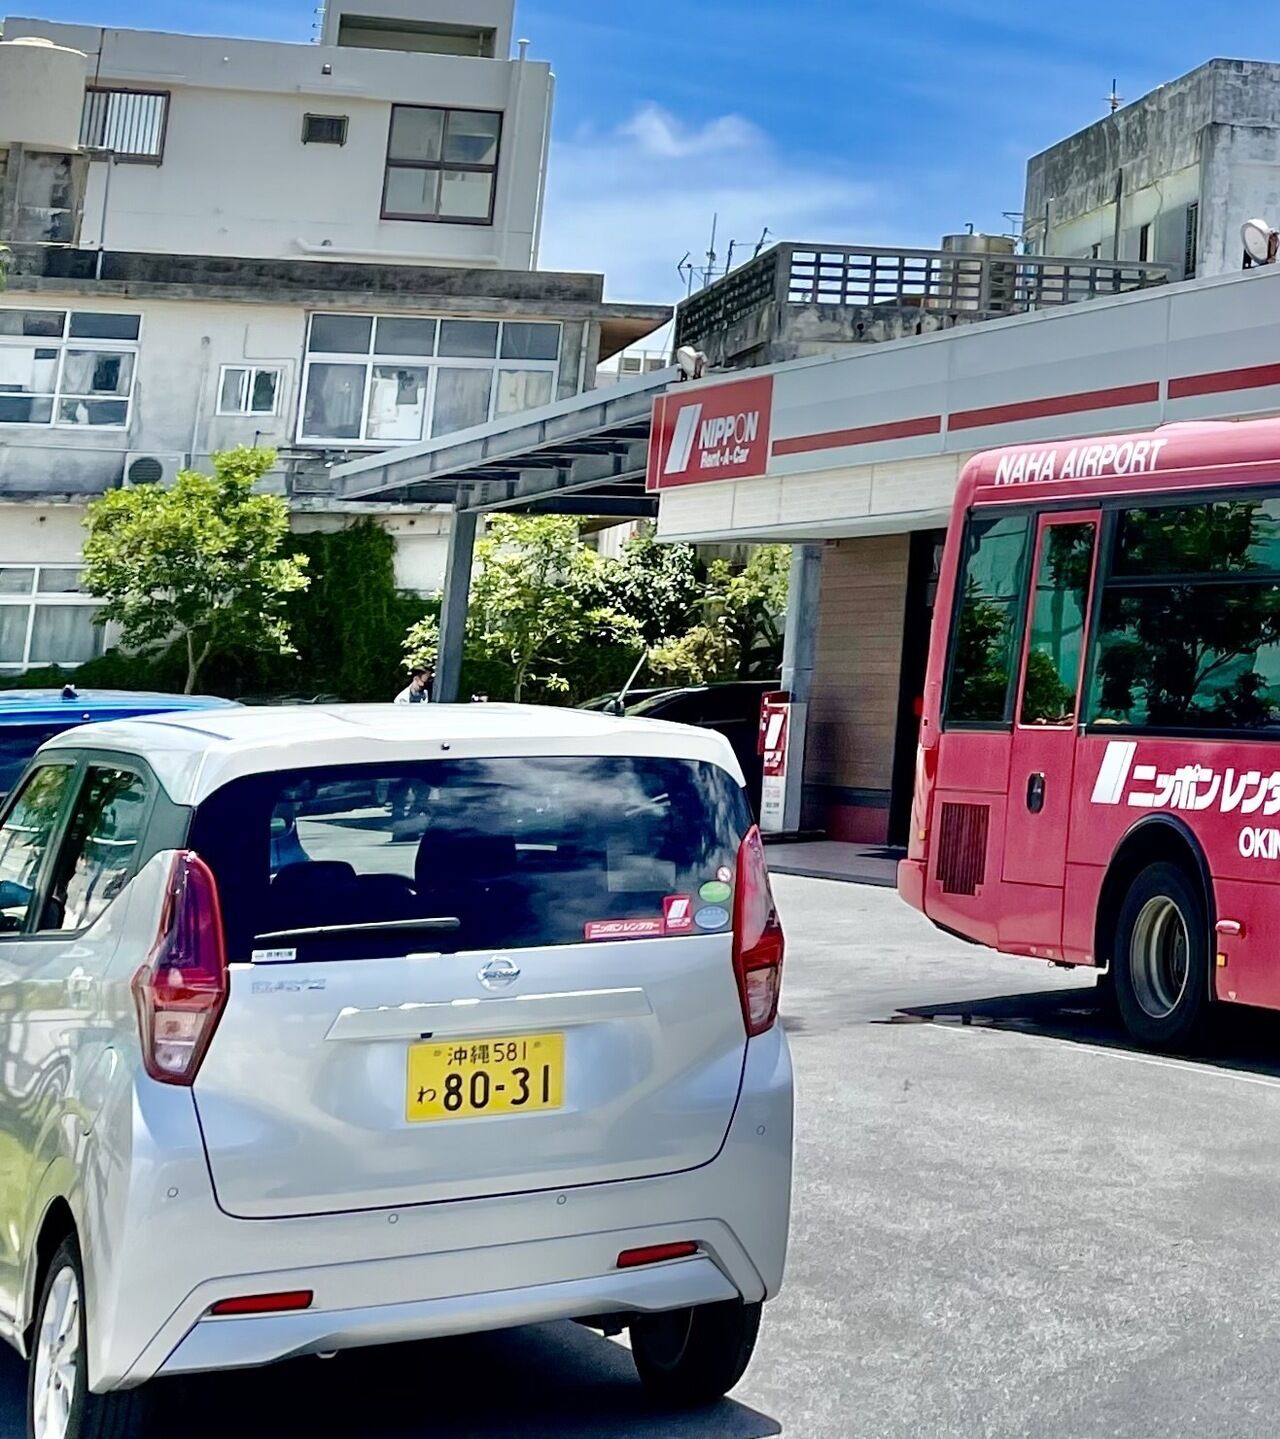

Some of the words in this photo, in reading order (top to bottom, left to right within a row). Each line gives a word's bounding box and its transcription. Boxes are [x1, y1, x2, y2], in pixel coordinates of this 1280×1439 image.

[698, 410, 760, 450] NIPPON
[994, 449, 1058, 486] NAHA
[1059, 438, 1168, 480] AIRPORT
[447, 1041, 527, 1066] 沖縄581
[416, 1085, 437, 1105] わ
[443, 1064, 550, 1111] 80-31
